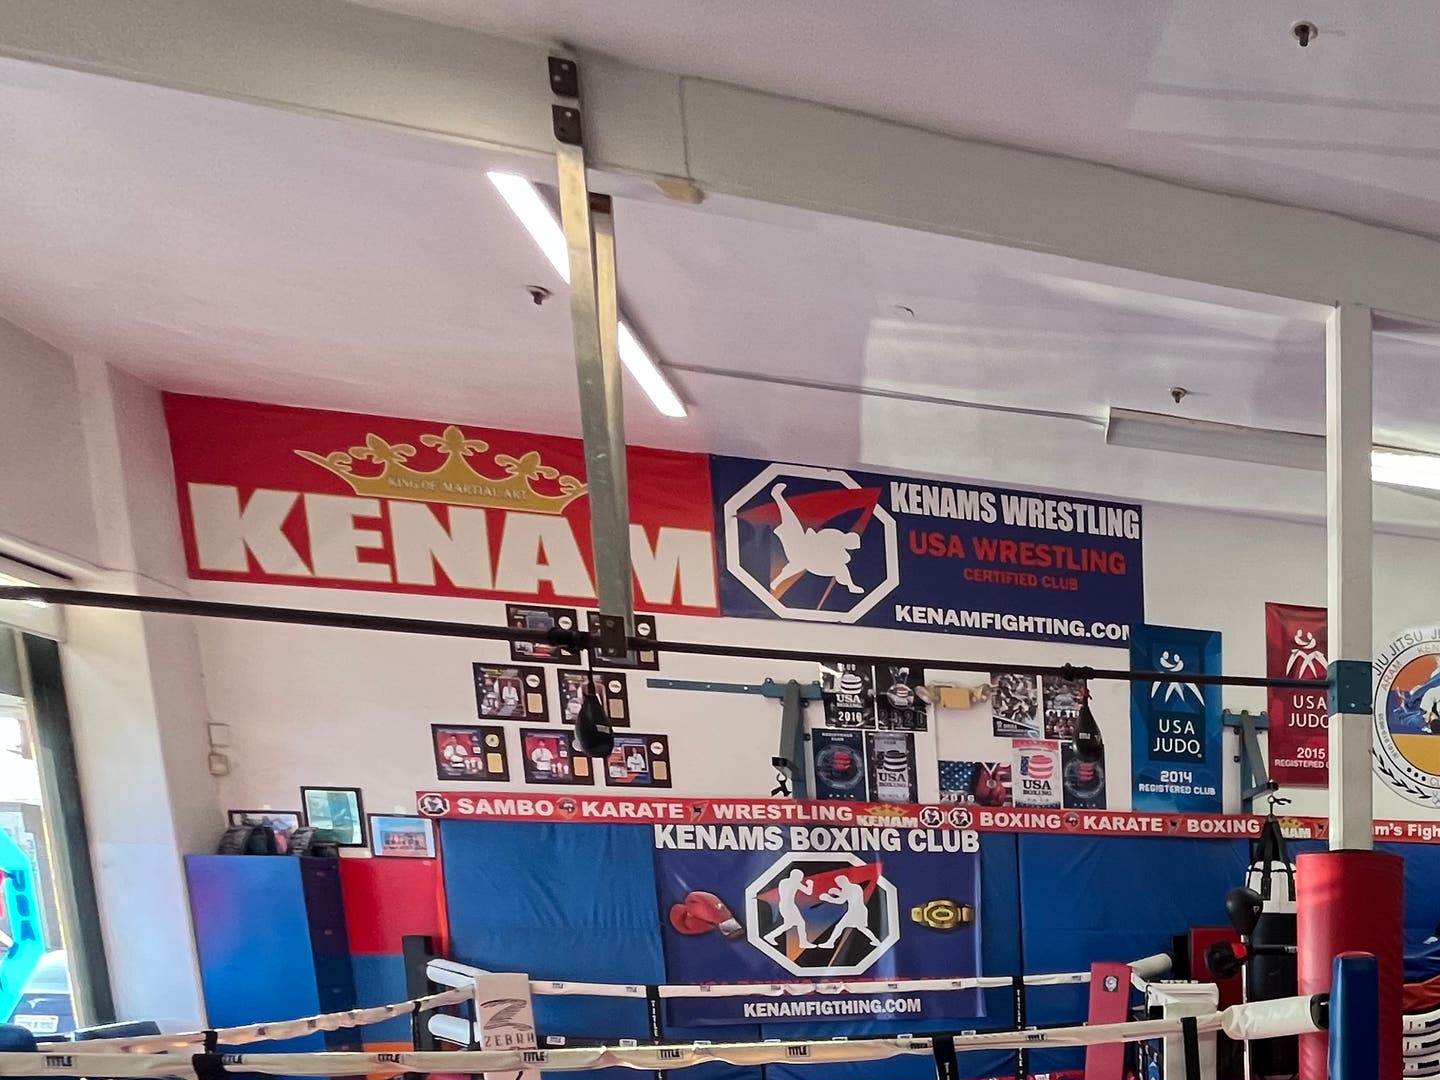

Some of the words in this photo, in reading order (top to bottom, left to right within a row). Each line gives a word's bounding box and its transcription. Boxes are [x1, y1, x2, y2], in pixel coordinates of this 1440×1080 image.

[890, 481, 997, 524] KENAMS
[1001, 494, 1140, 540] WRESTLING
[187, 482, 718, 607] KENAM
[909, 529, 965, 559] USA
[973, 536, 1127, 576] WRESTLING
[964, 567, 1038, 587] CERTIFIED
[1042, 575, 1079, 591] CLUB
[1373, 653, 1390, 677] JIU
[1389, 630, 1423, 655] JITSU
[836, 694, 861, 703] USA
[1293, 694, 1328, 710] USA
[1159, 719, 1195, 735] USA
[1288, 713, 1329, 728] JUDO
[1297, 747, 1326, 760] 2015
[1274, 759, 1325, 768] REGISTERED
[879, 772, 907, 782] USA
[1160, 770, 1193, 783] 2014
[1022, 780, 1052, 790] USA
[1139, 783, 1192, 794] REGISTERED
[1193, 786, 1216, 796] CLUB
[457, 798, 554, 816] SAMBO
[582, 801, 685, 819] KARATE
[712, 804, 853, 821] WRESTLING
[856, 815, 918, 828] KENAM
[980, 812, 1061, 829] BOXING
[1083, 815, 1163, 832] KARATE
[1187, 819, 1260, 834] BOXING
[654, 824, 784, 851] KENAMS
[790, 826, 901, 852] BOXING
[907, 829, 980, 853] CLUB
[743, 998, 921, 1018] KENAMFIGTHING.COM
[484, 1032, 536, 1047] ZEBRA
[378, 1053, 400, 1062] TITLE
[523, 1052, 545, 1061] TITLE
[660, 1049, 680, 1058] TITLE
[788, 1046, 807, 1056] TITLE
[46, 1056, 73, 1066] TITLE
